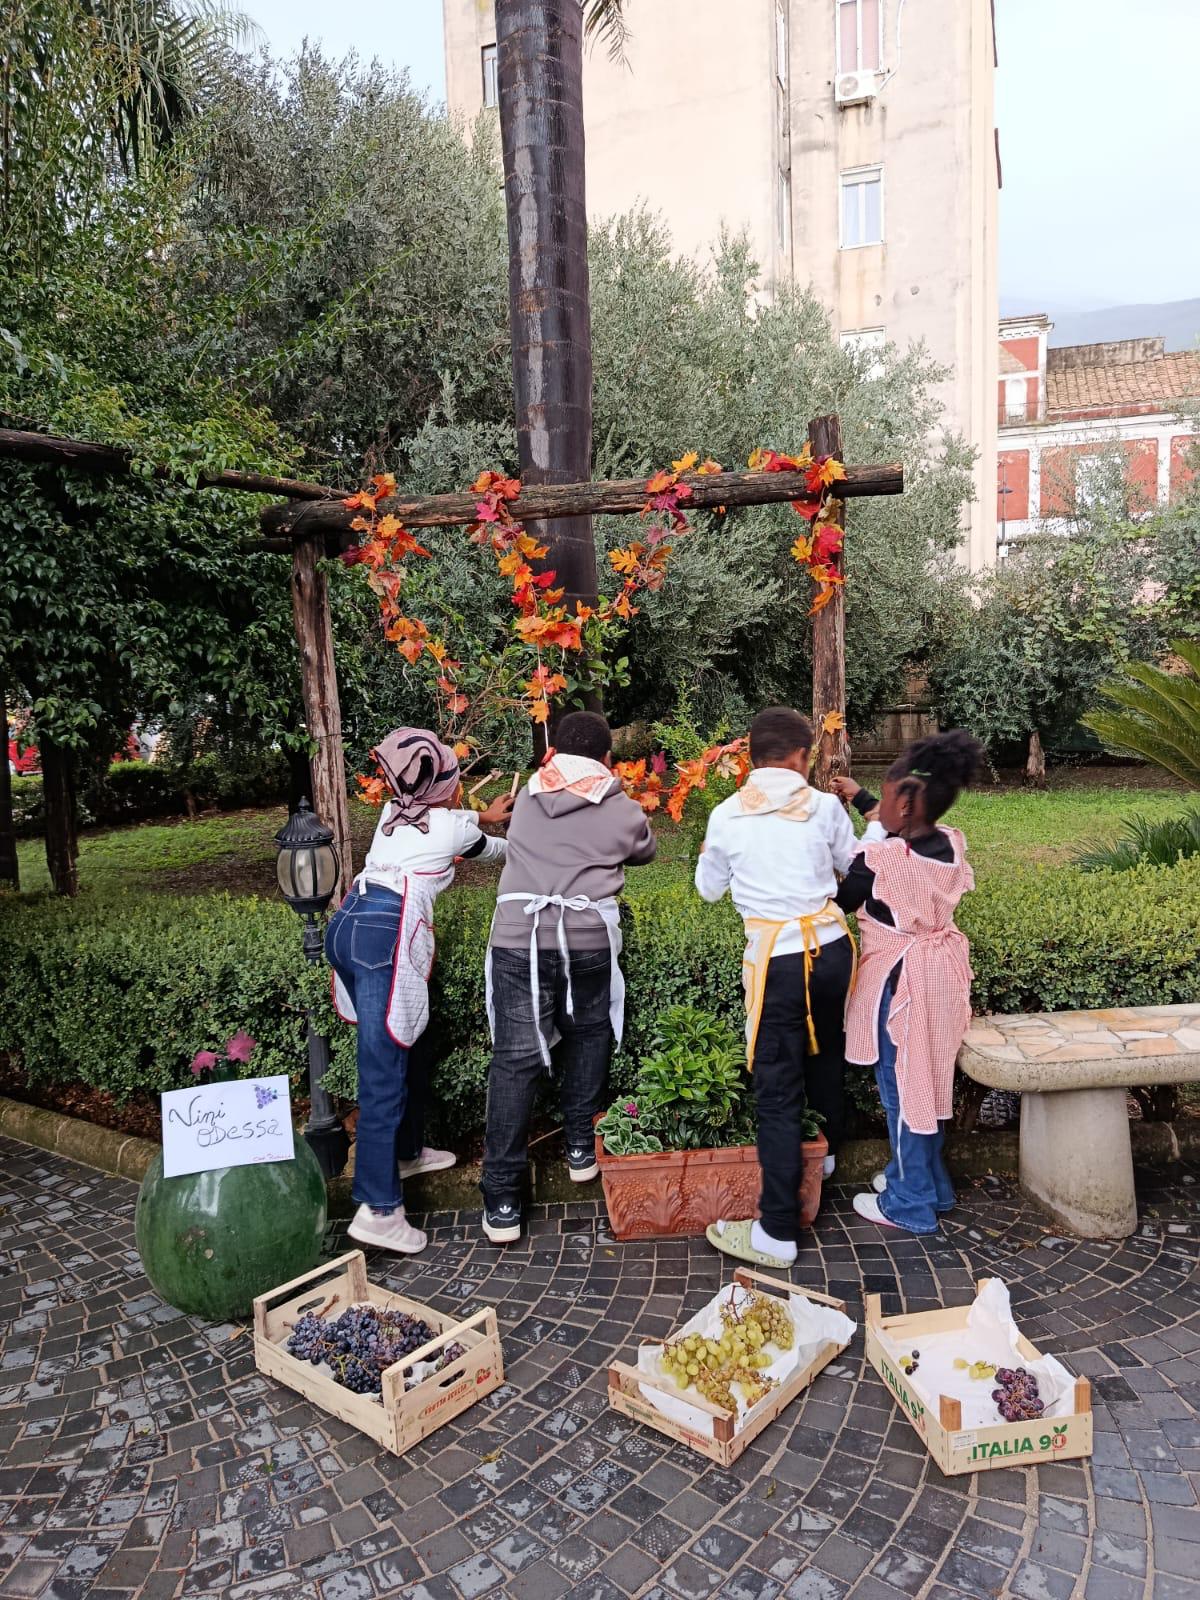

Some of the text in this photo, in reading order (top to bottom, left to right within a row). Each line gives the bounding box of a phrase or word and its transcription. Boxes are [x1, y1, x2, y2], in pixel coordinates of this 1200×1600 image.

[168, 1095, 226, 1127] Vini
[881, 1358, 910, 1409] ITALIA
[972, 1437, 1034, 1460] ITALIA
